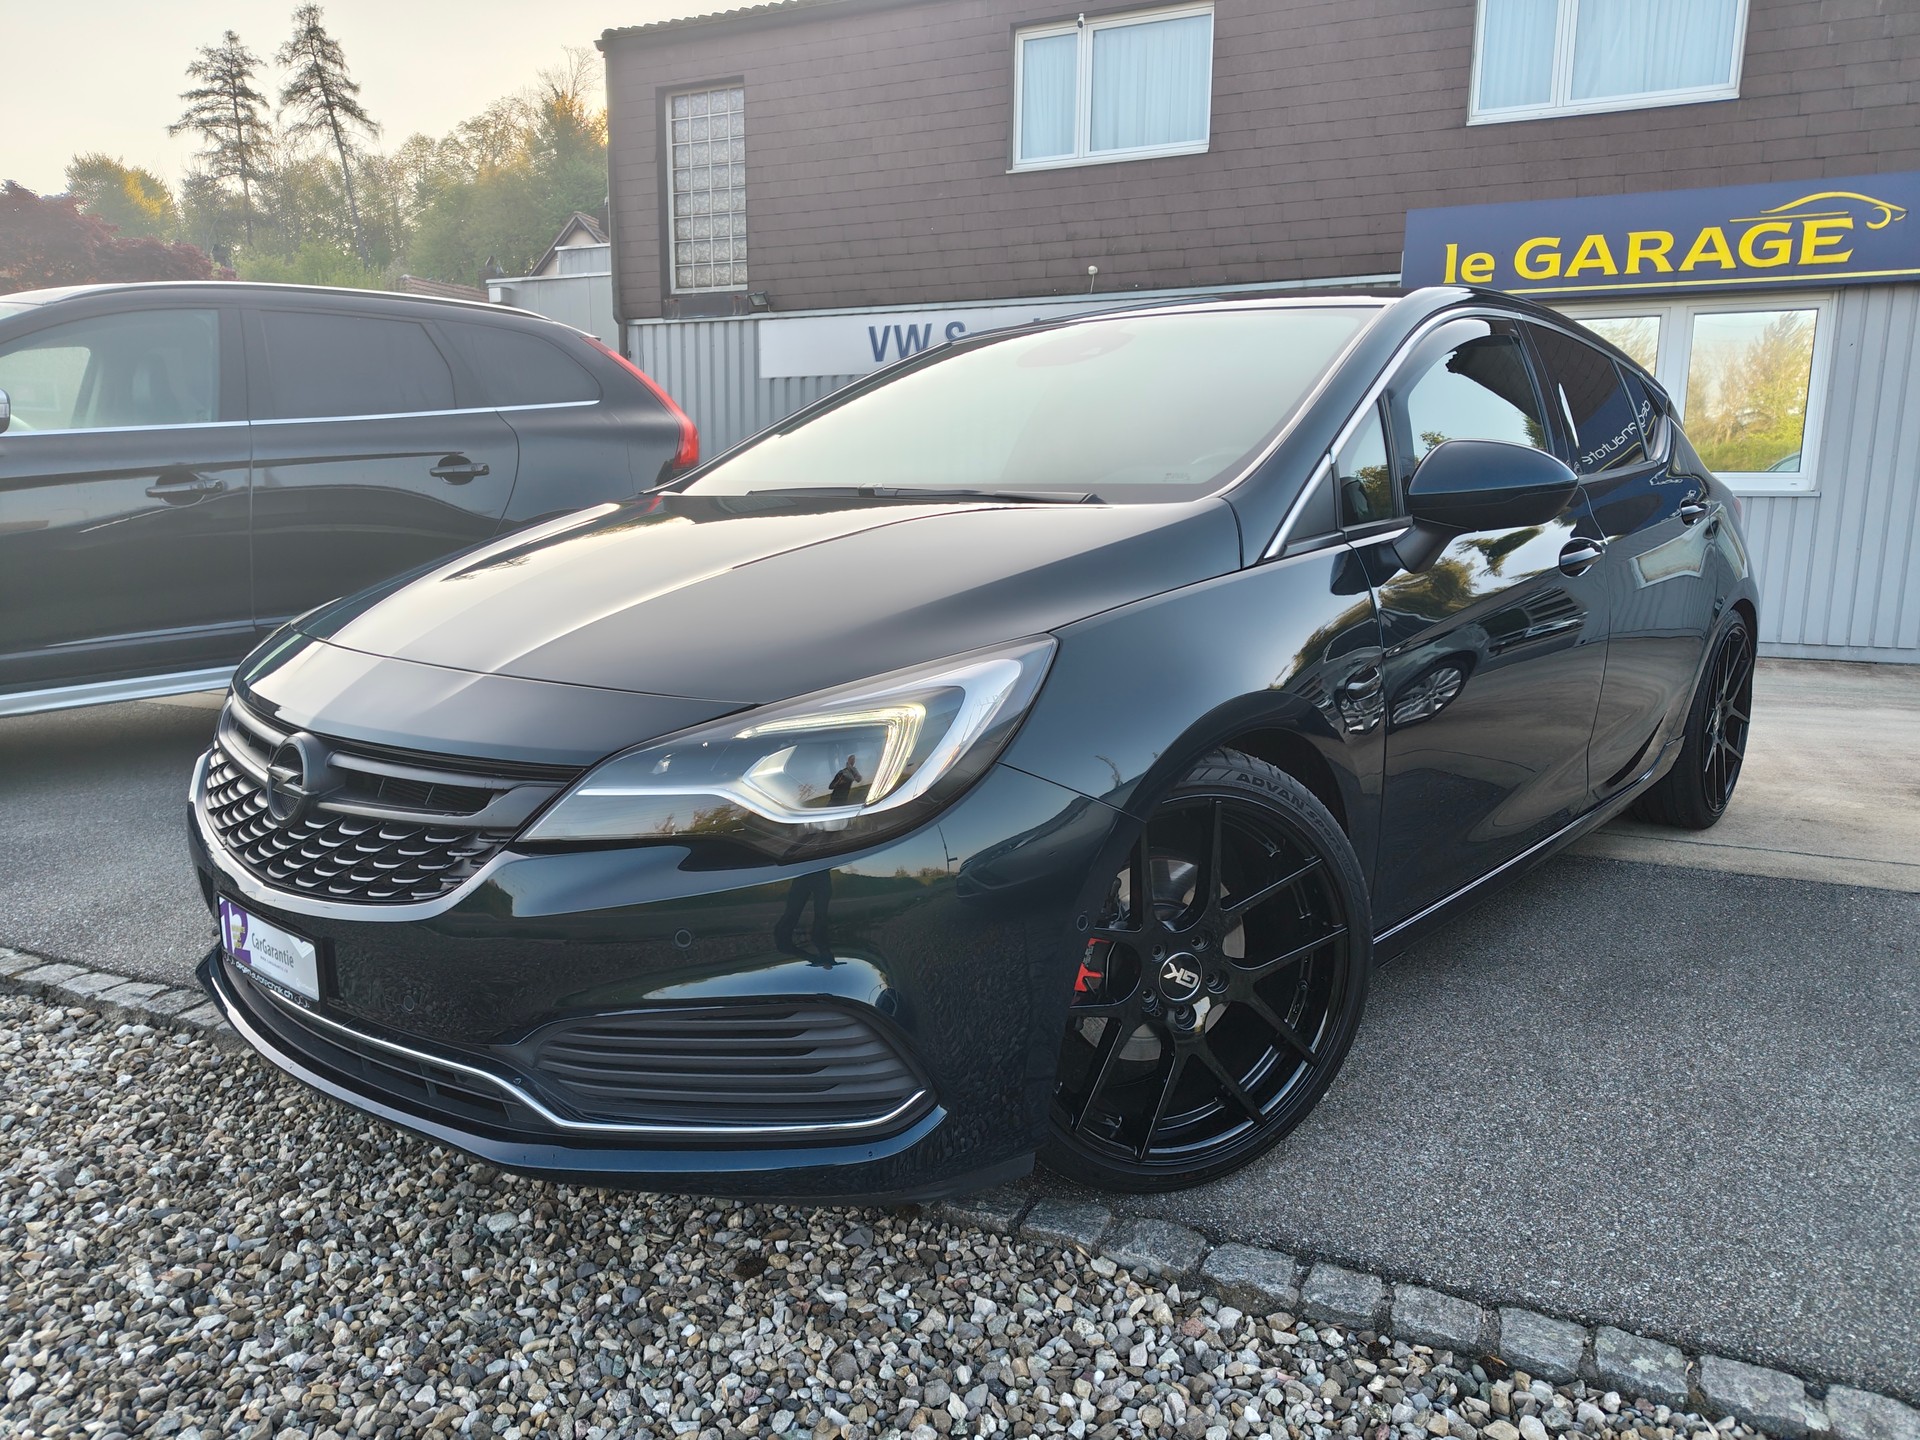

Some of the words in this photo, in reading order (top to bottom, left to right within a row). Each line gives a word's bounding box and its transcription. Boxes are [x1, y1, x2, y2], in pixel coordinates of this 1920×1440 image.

[1443, 243, 1495, 284] le
[1514, 217, 1854, 280] GARAGE
[868, 322, 932, 362] VW
[1236, 773, 1306, 810] ADVAN
[251, 932, 294, 968] CarGarantie
